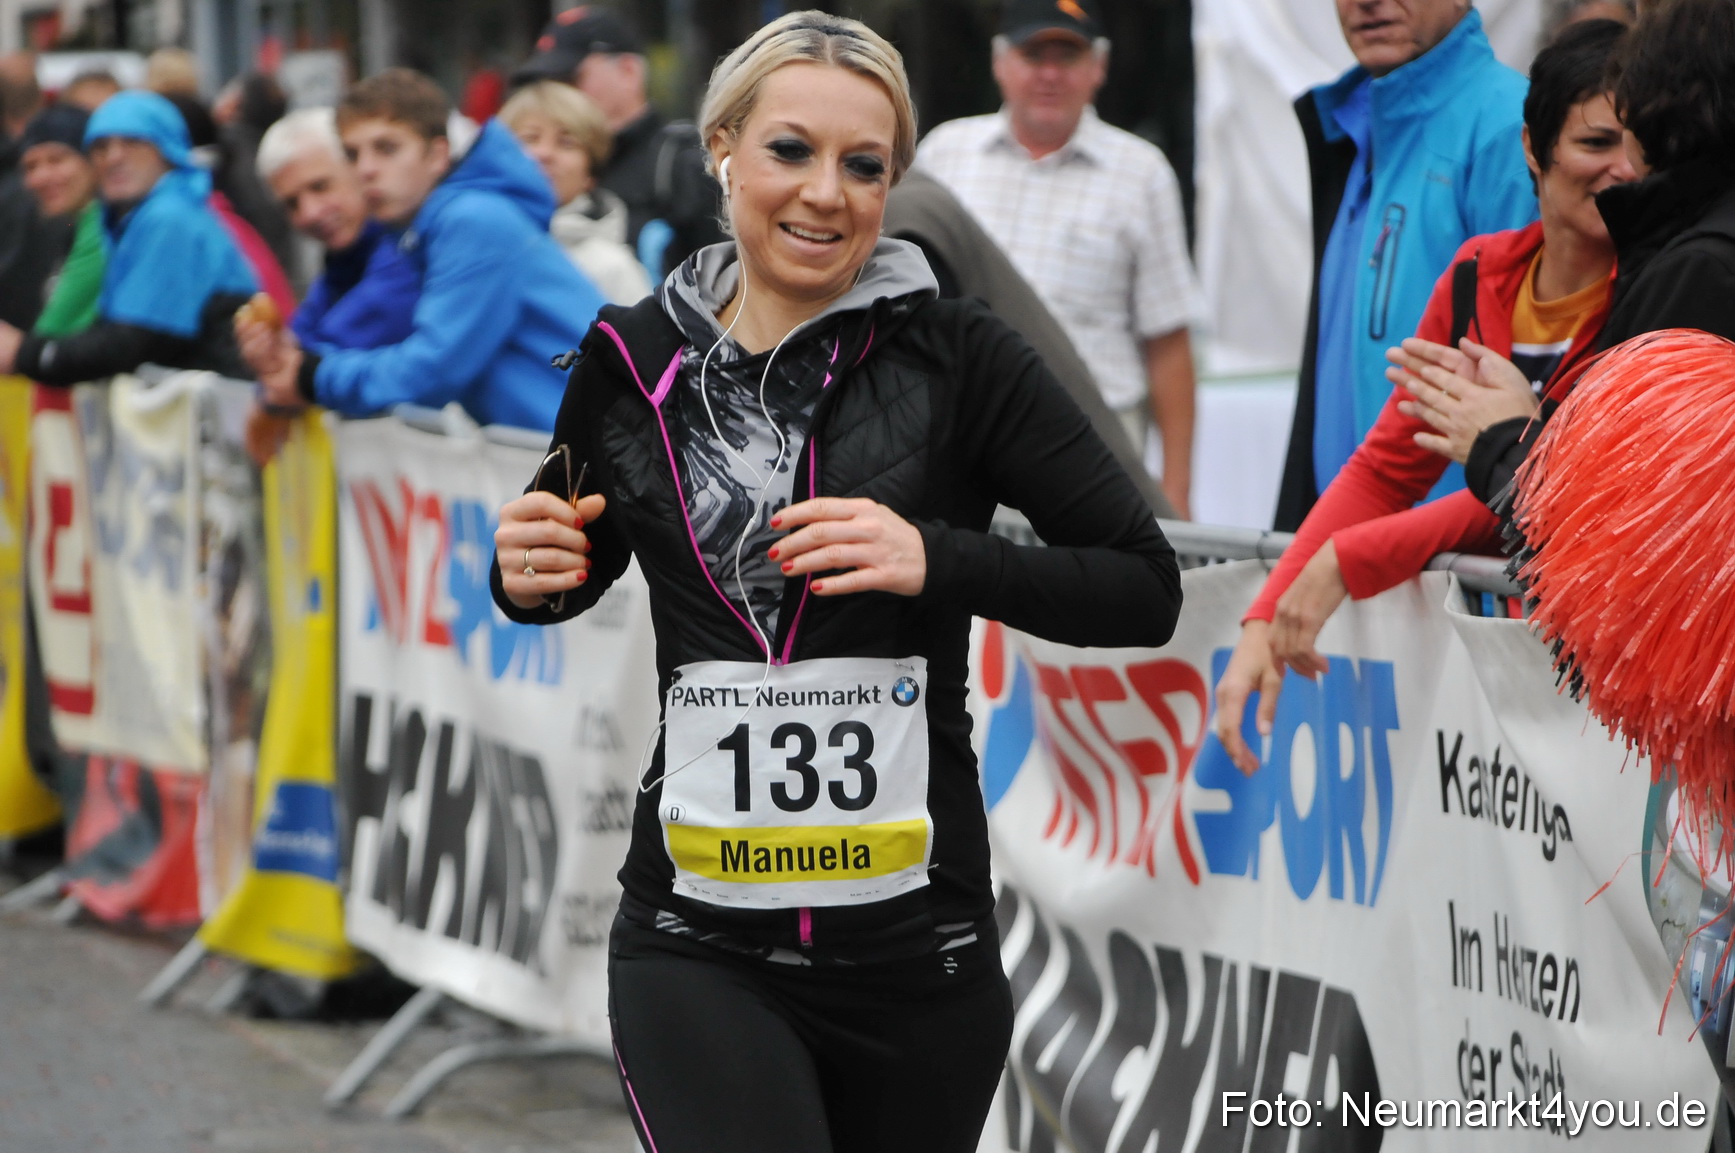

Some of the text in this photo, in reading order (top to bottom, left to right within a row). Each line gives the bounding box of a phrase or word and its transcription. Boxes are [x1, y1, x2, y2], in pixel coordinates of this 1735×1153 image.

[671, 684, 882, 707] PARTL Neumarkt
[717, 720, 878, 813] 133
[720, 838, 871, 873] Manuela
[1448, 899, 1483, 993] Im
